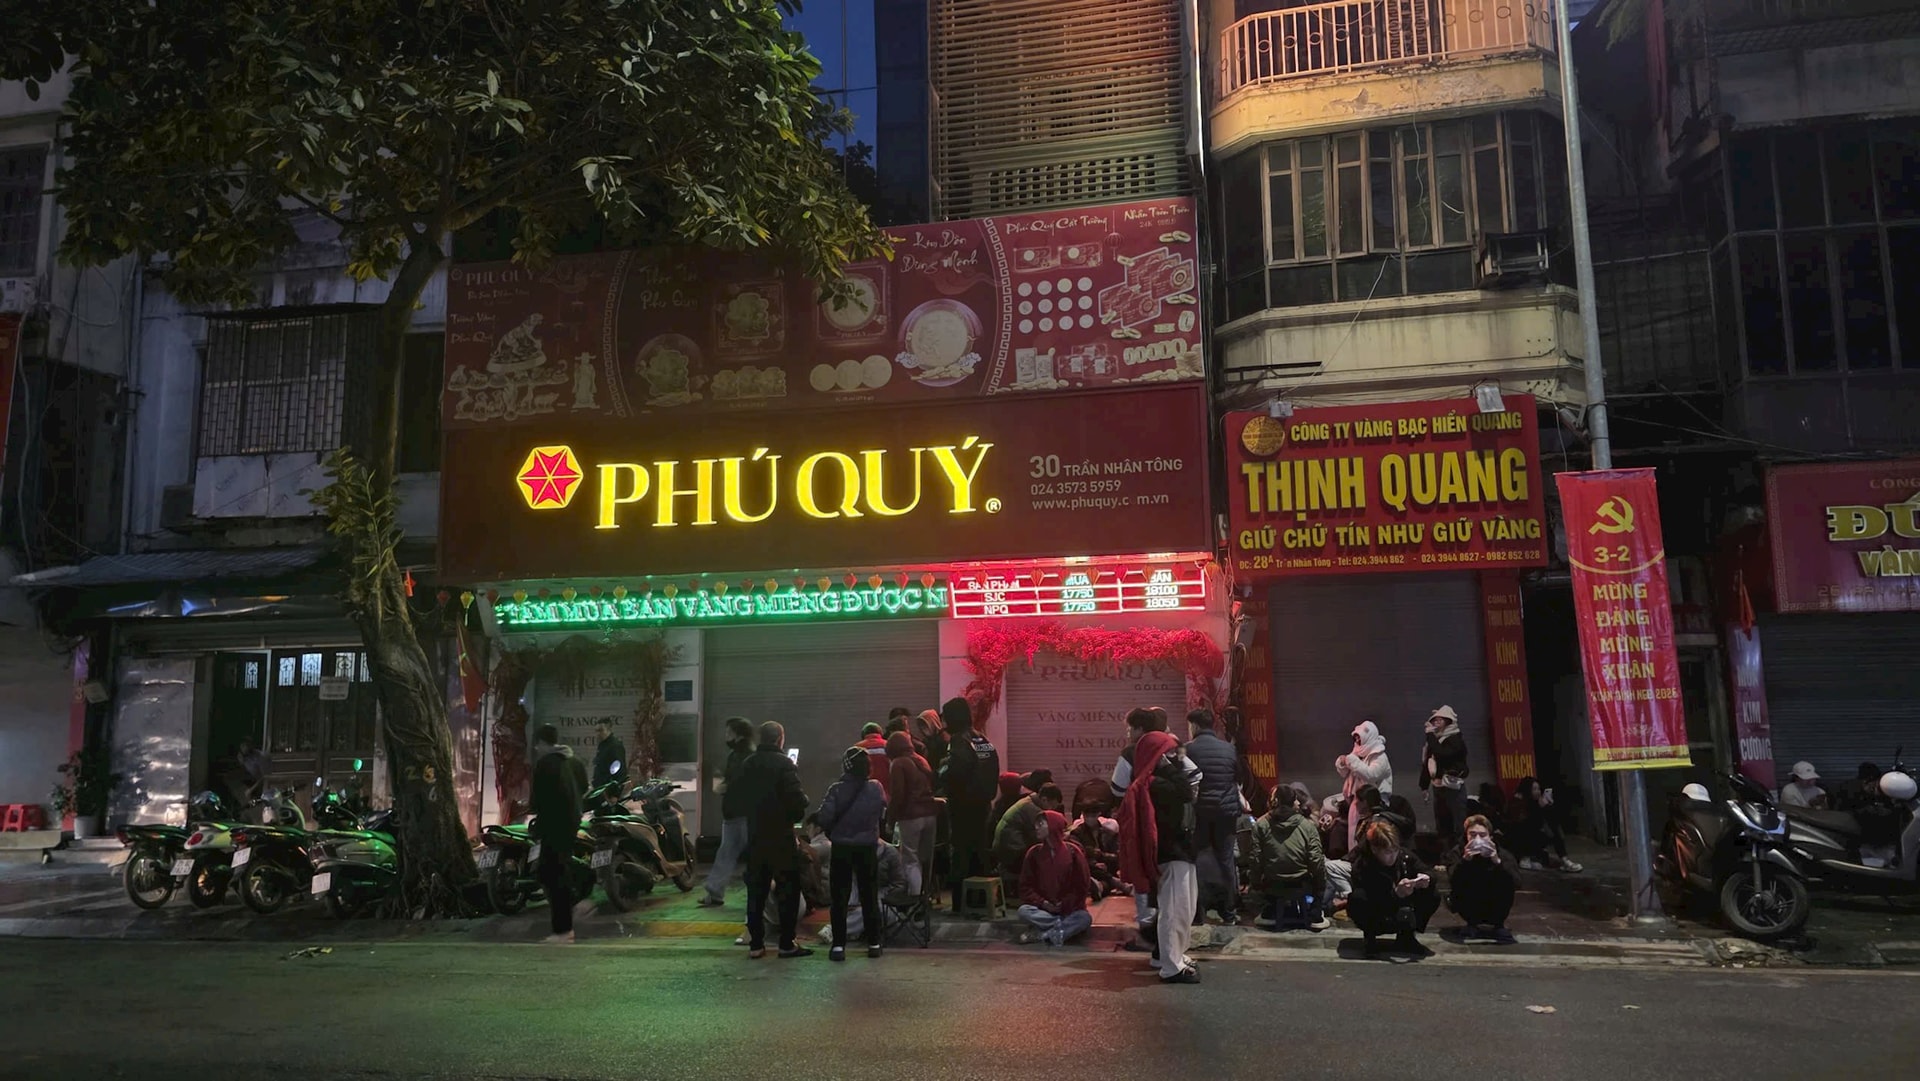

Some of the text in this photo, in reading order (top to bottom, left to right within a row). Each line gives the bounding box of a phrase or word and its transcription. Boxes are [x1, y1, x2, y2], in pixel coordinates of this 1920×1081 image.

[1291, 418, 1329, 441] CÔNG
[1334, 422, 1350, 438] TY
[1354, 416, 1393, 438] VÀNG
[1398, 416, 1427, 439] BẠC
[1472, 412, 1522, 432] QUANG
[1030, 454, 1183, 478] 30 TRẦN NHÂN TÔNG
[594, 447, 782, 529] PHÚ
[796, 436, 994, 518] QUÝ
[1031, 479, 1122, 496] 024 3573 5959
[1241, 447, 1529, 521] THỊNH QUANG
[1032, 494, 1169, 511] www.phuquy.cm.vn
[1239, 514, 1541, 550] GIỮ CHỮ TÍN NHƯ GIỮ VÀNG
[1276, 558, 1292, 568] Trn
[1338, 556, 1352, 566] Tel:
[1438, 553, 1458, 563] 3944
[1594, 545, 1631, 563] 3-2
[984, 592, 1006, 602] SJC
[1062, 588, 1095, 600] 17750
[1593, 580, 1648, 601] MỪNG
[680, 590, 754, 618] VÀNG
[843, 586, 923, 614] ĐƯỢC
[984, 604, 1009, 615] NPQ
[1063, 601, 1097, 612] 17750
[1595, 606, 1650, 627] ĐẢNG
[1602, 660, 1656, 681] XUÂN
[1135, 683, 1169, 691] GOLD
[1743, 701, 1762, 724] KIM
[1504, 712, 1523, 743] QUÝ
[1500, 749, 1534, 779] KHÁCH
